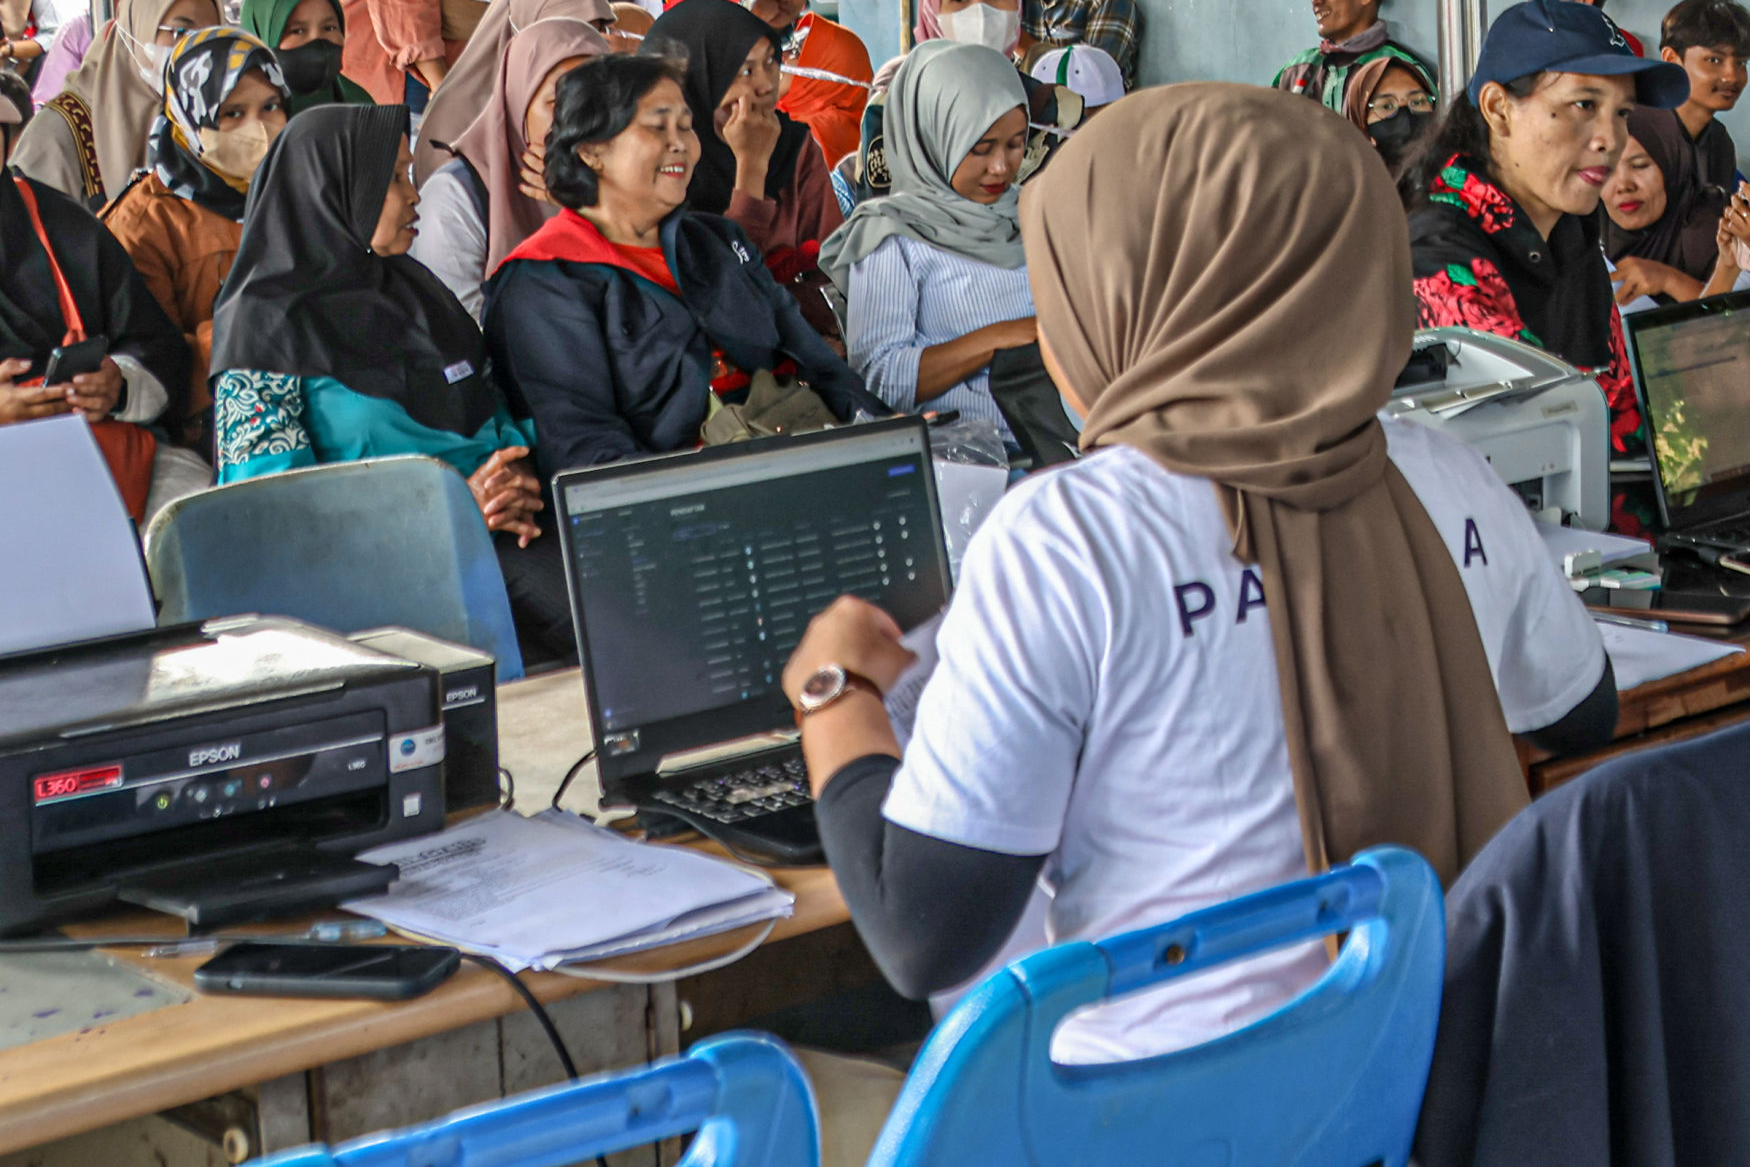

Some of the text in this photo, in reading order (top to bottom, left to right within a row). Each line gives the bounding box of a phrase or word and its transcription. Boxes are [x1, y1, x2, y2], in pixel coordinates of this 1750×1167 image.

[446, 688, 478, 703] EPSON
[189, 742, 241, 767] EPSON
[37, 777, 77, 798] L360
